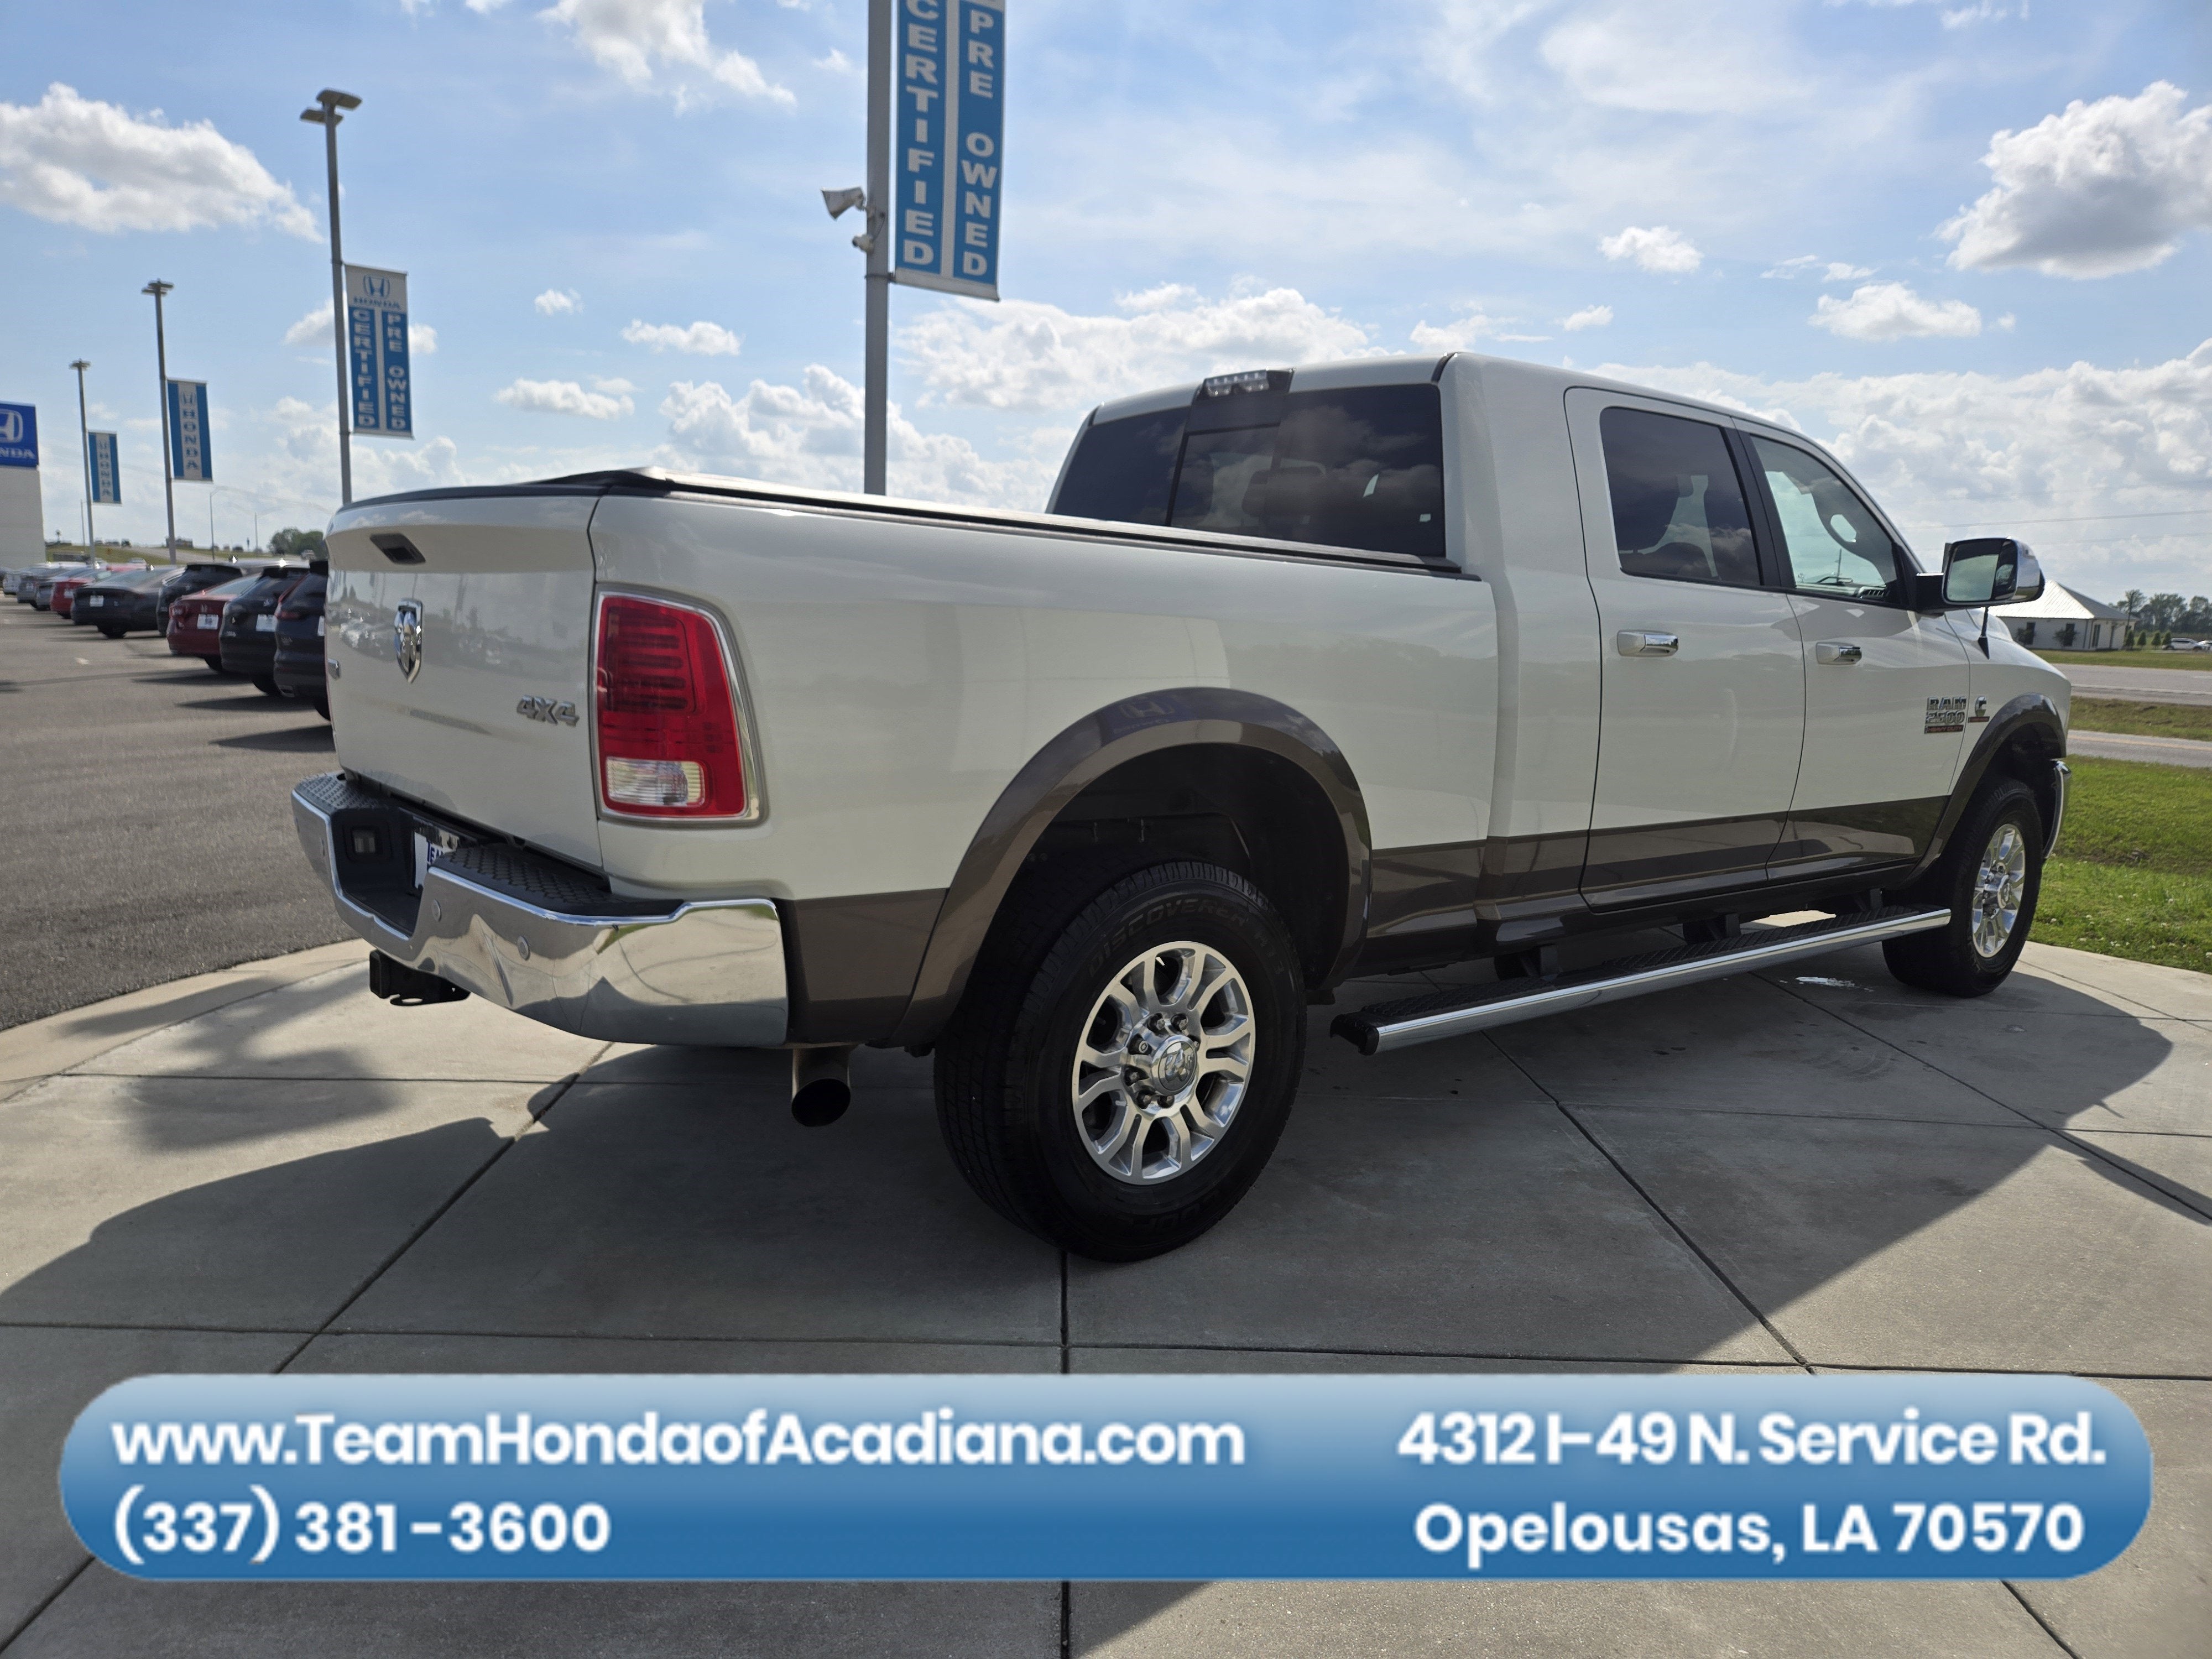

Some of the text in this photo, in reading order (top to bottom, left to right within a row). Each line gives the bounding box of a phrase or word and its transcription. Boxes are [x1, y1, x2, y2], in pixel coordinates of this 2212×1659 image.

[902, 0, 939, 265] CERTIFIED
[961, 9, 998, 276] PRE OWNED
[353, 295, 401, 309] HONDA
[353, 308, 375, 429] CERTIFIED
[387, 314, 407, 430] PRE OWNED
[0, 447, 36, 460] NDA
[182, 409, 199, 470] HONDA
[1925, 710, 1965, 725] 2500
[1927, 696, 1967, 711] RAM
[1087, 898, 1249, 978] DISCOVERER
